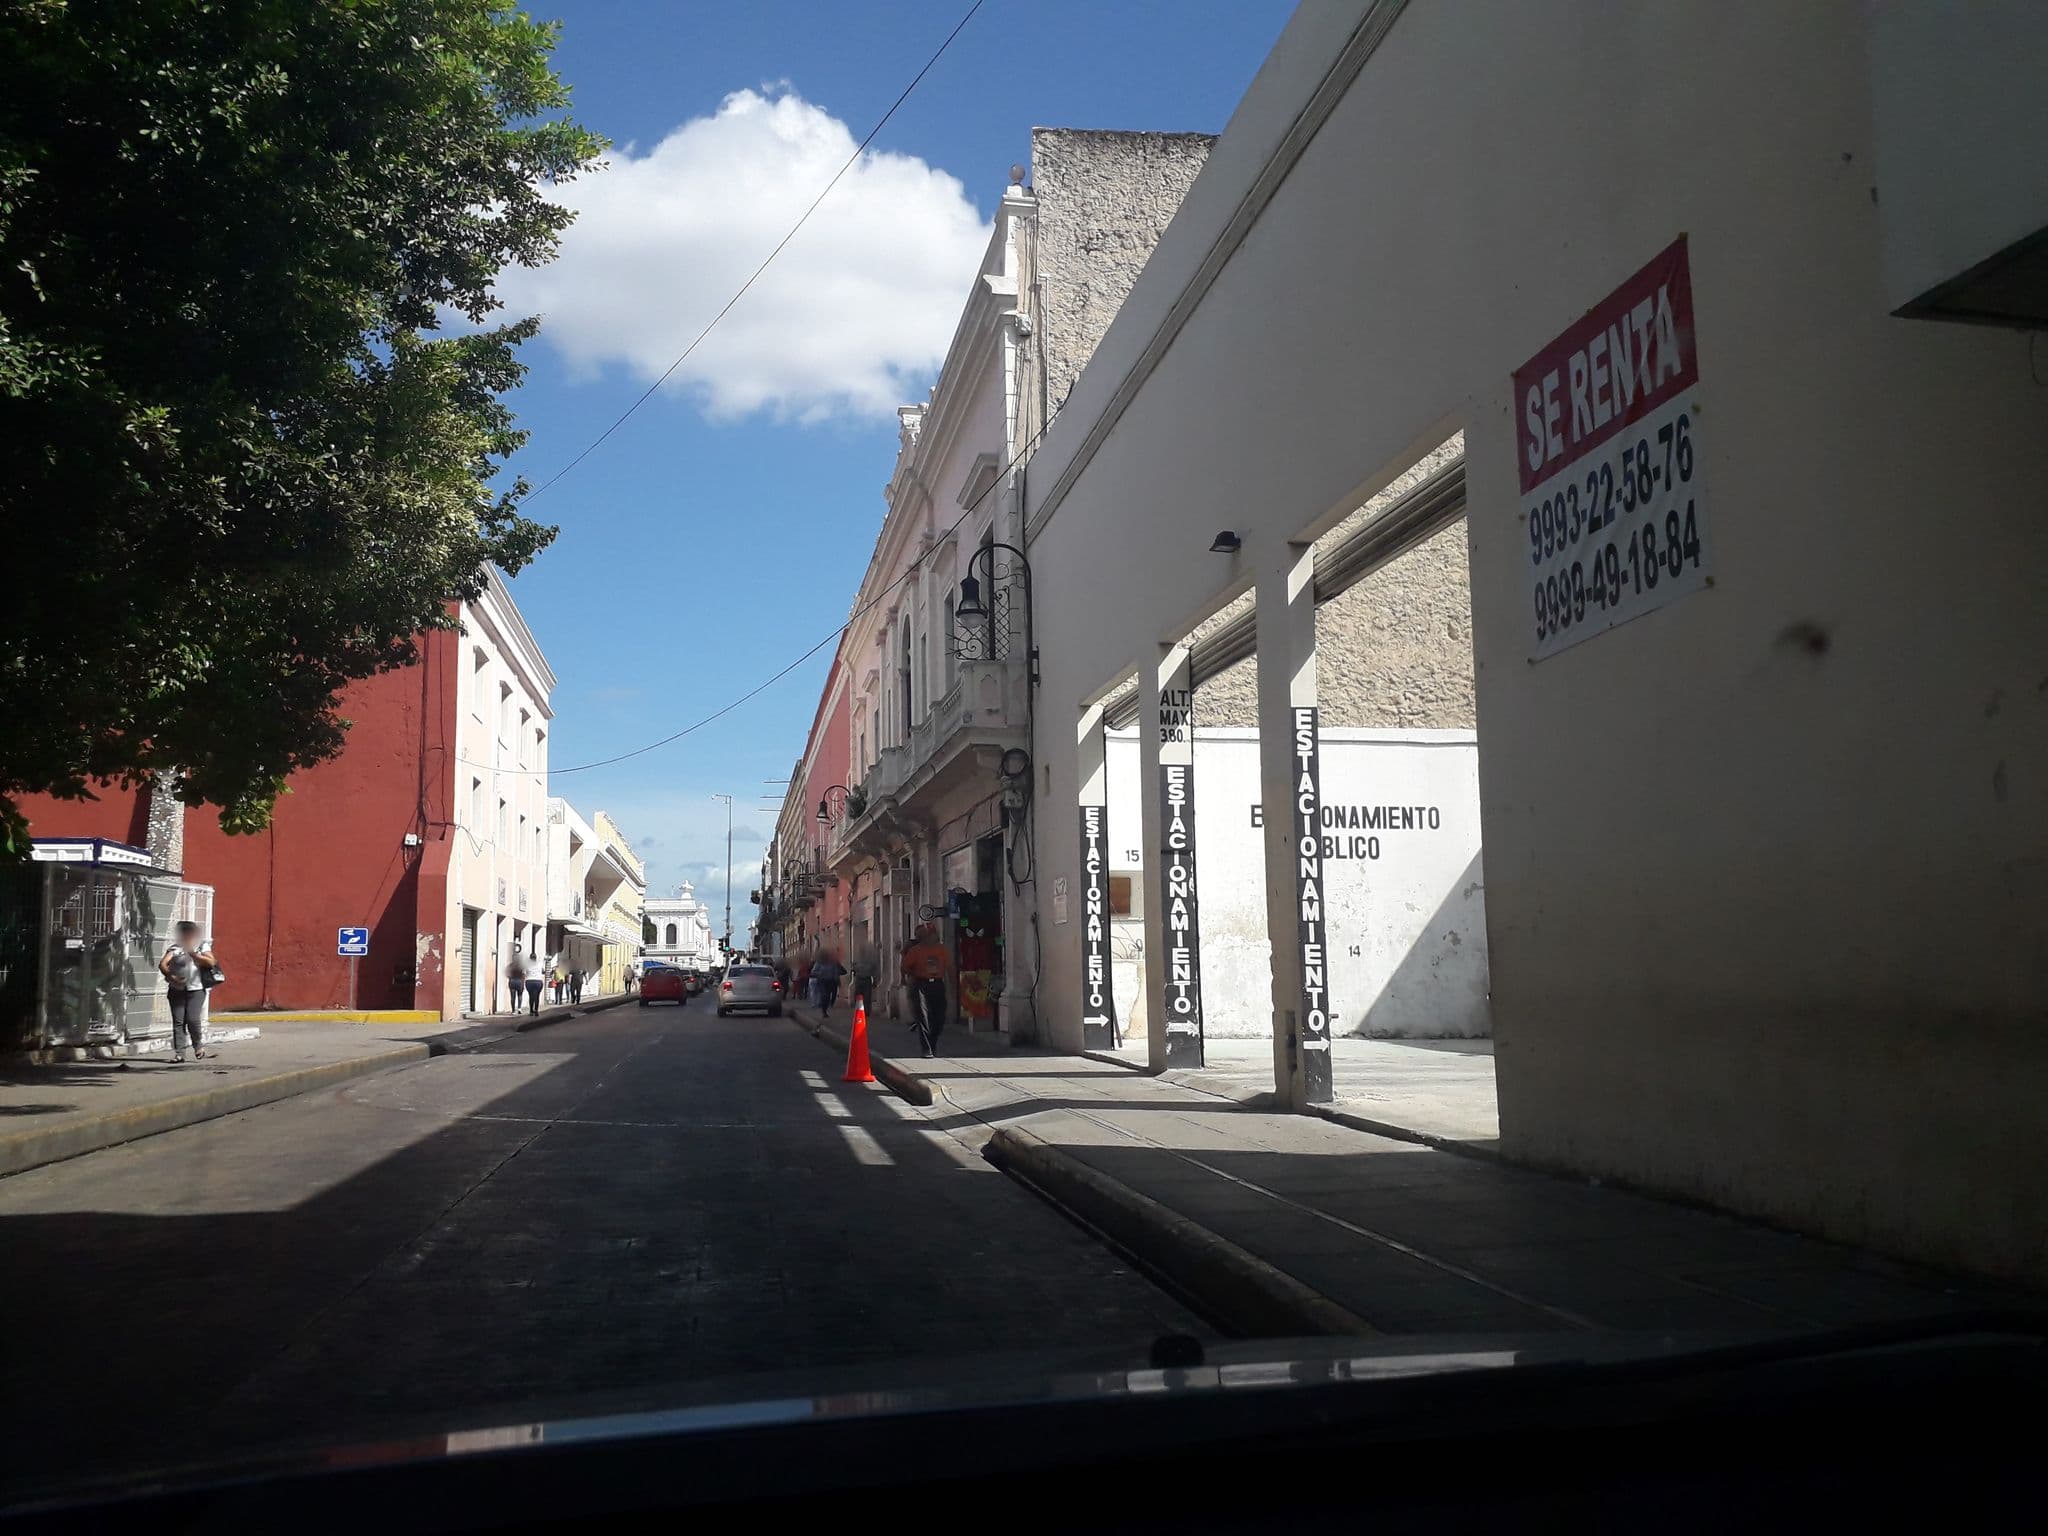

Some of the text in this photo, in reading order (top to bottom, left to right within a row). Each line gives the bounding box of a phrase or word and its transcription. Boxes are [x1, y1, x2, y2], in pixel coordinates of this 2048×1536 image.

[1526, 284, 1682, 472] SE RENTA
[1529, 413, 1694, 566] 9993-22-58-76
[1534, 499, 1700, 641] 9999-49-18-84
[1160, 690, 1190, 707] ALT.
[1160, 710, 1189, 726] MAX
[1125, 850, 1140, 862] 15
[1251, 805, 1440, 830] EONAMIENTO
[1322, 836, 1380, 860] BLICO
[1085, 808, 1103, 1007] ESTACIONAMIENTO
[1166, 767, 1191, 1014] ESTACIONAMIENTO
[1295, 709, 1324, 1032] ESTACIONAMIENTO
[1349, 945, 1361, 957] 14
